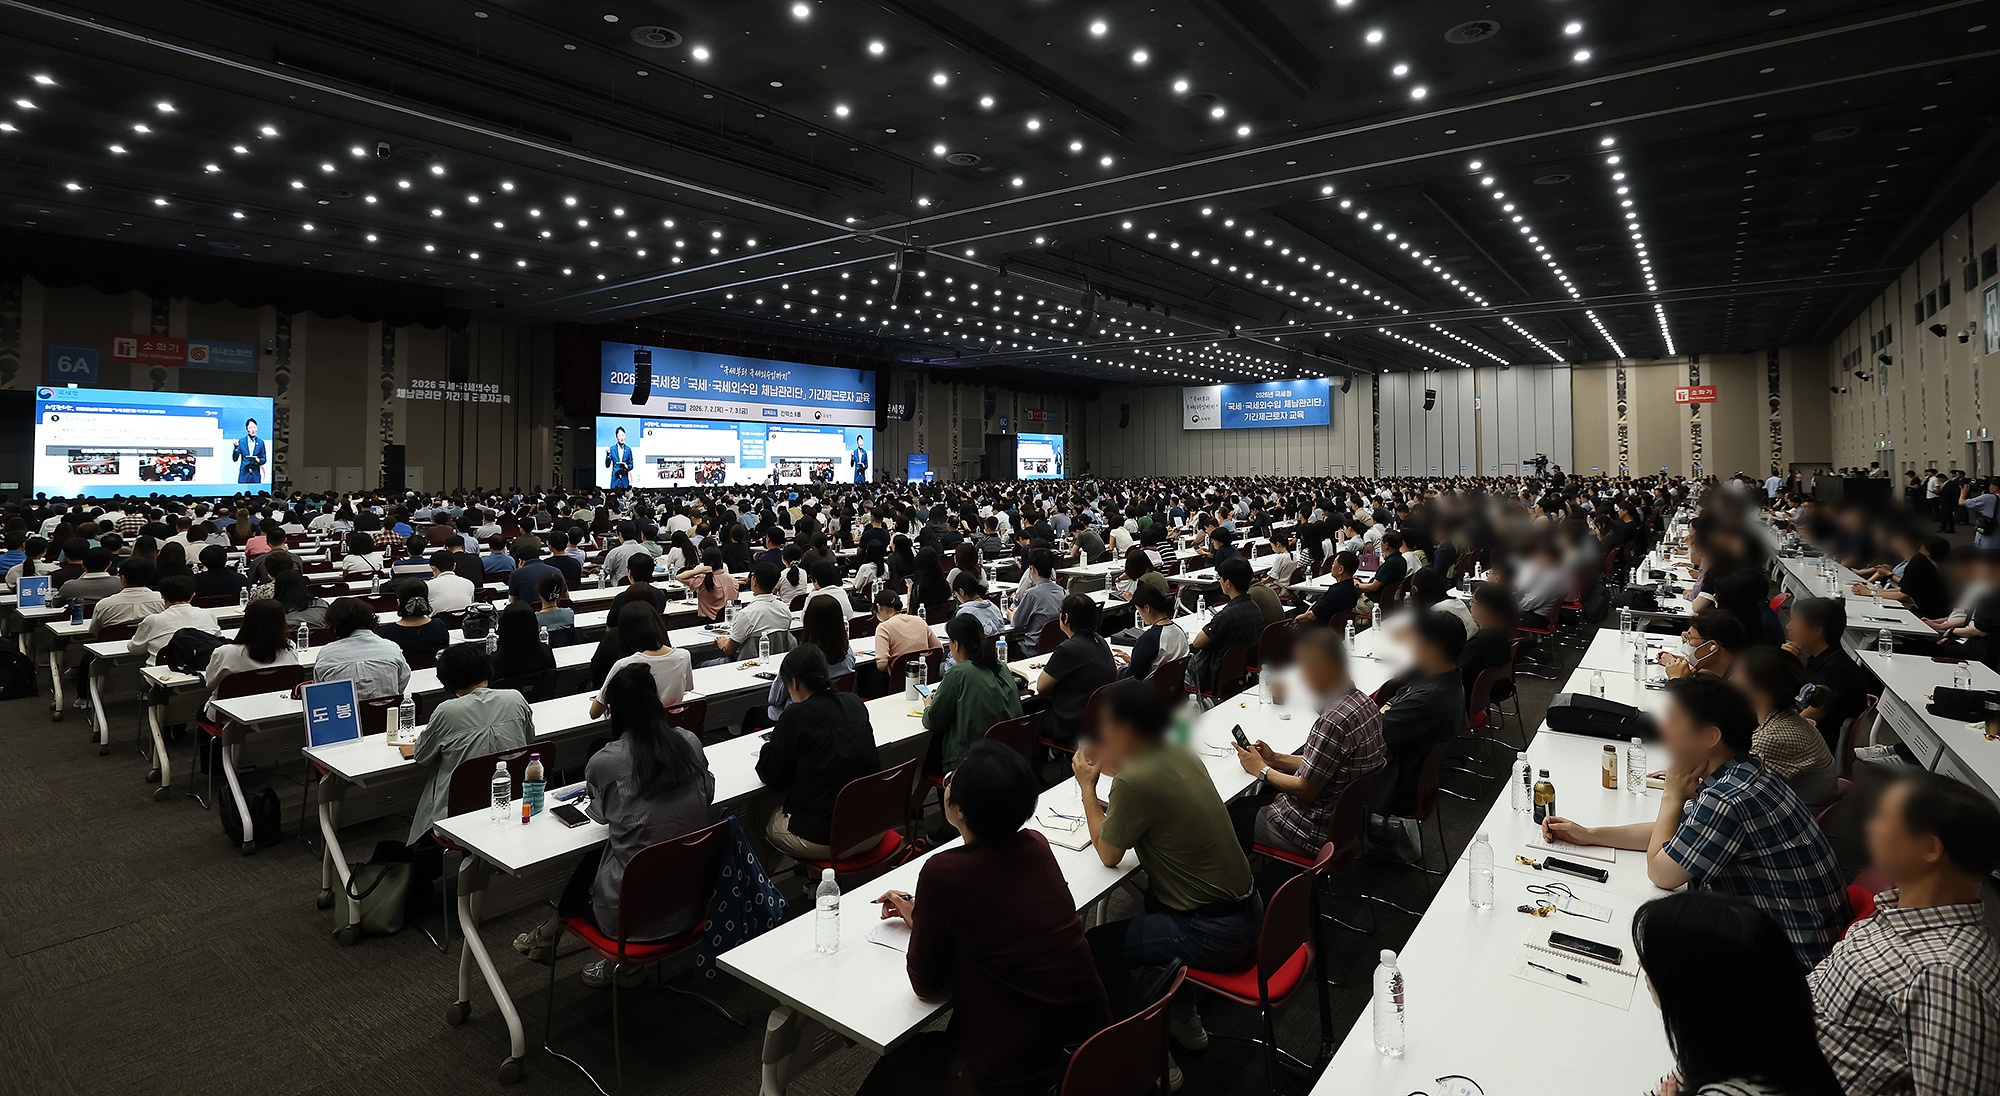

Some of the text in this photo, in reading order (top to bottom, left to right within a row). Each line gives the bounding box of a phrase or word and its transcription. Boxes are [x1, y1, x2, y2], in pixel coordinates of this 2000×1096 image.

[143, 342, 179, 353] 소화기
[57, 355, 90, 375] 6A
[412, 379, 436, 389] 2026
[651, 374, 680, 390] 국세청
[809, 388, 854, 402] 기간제근로자
[855, 392, 870, 403] 교육
[396, 388, 442, 400] 체납관리단
[1244, 410, 1304, 422] 기간제근로자 교육
[313, 703, 352, 723] 도봉
